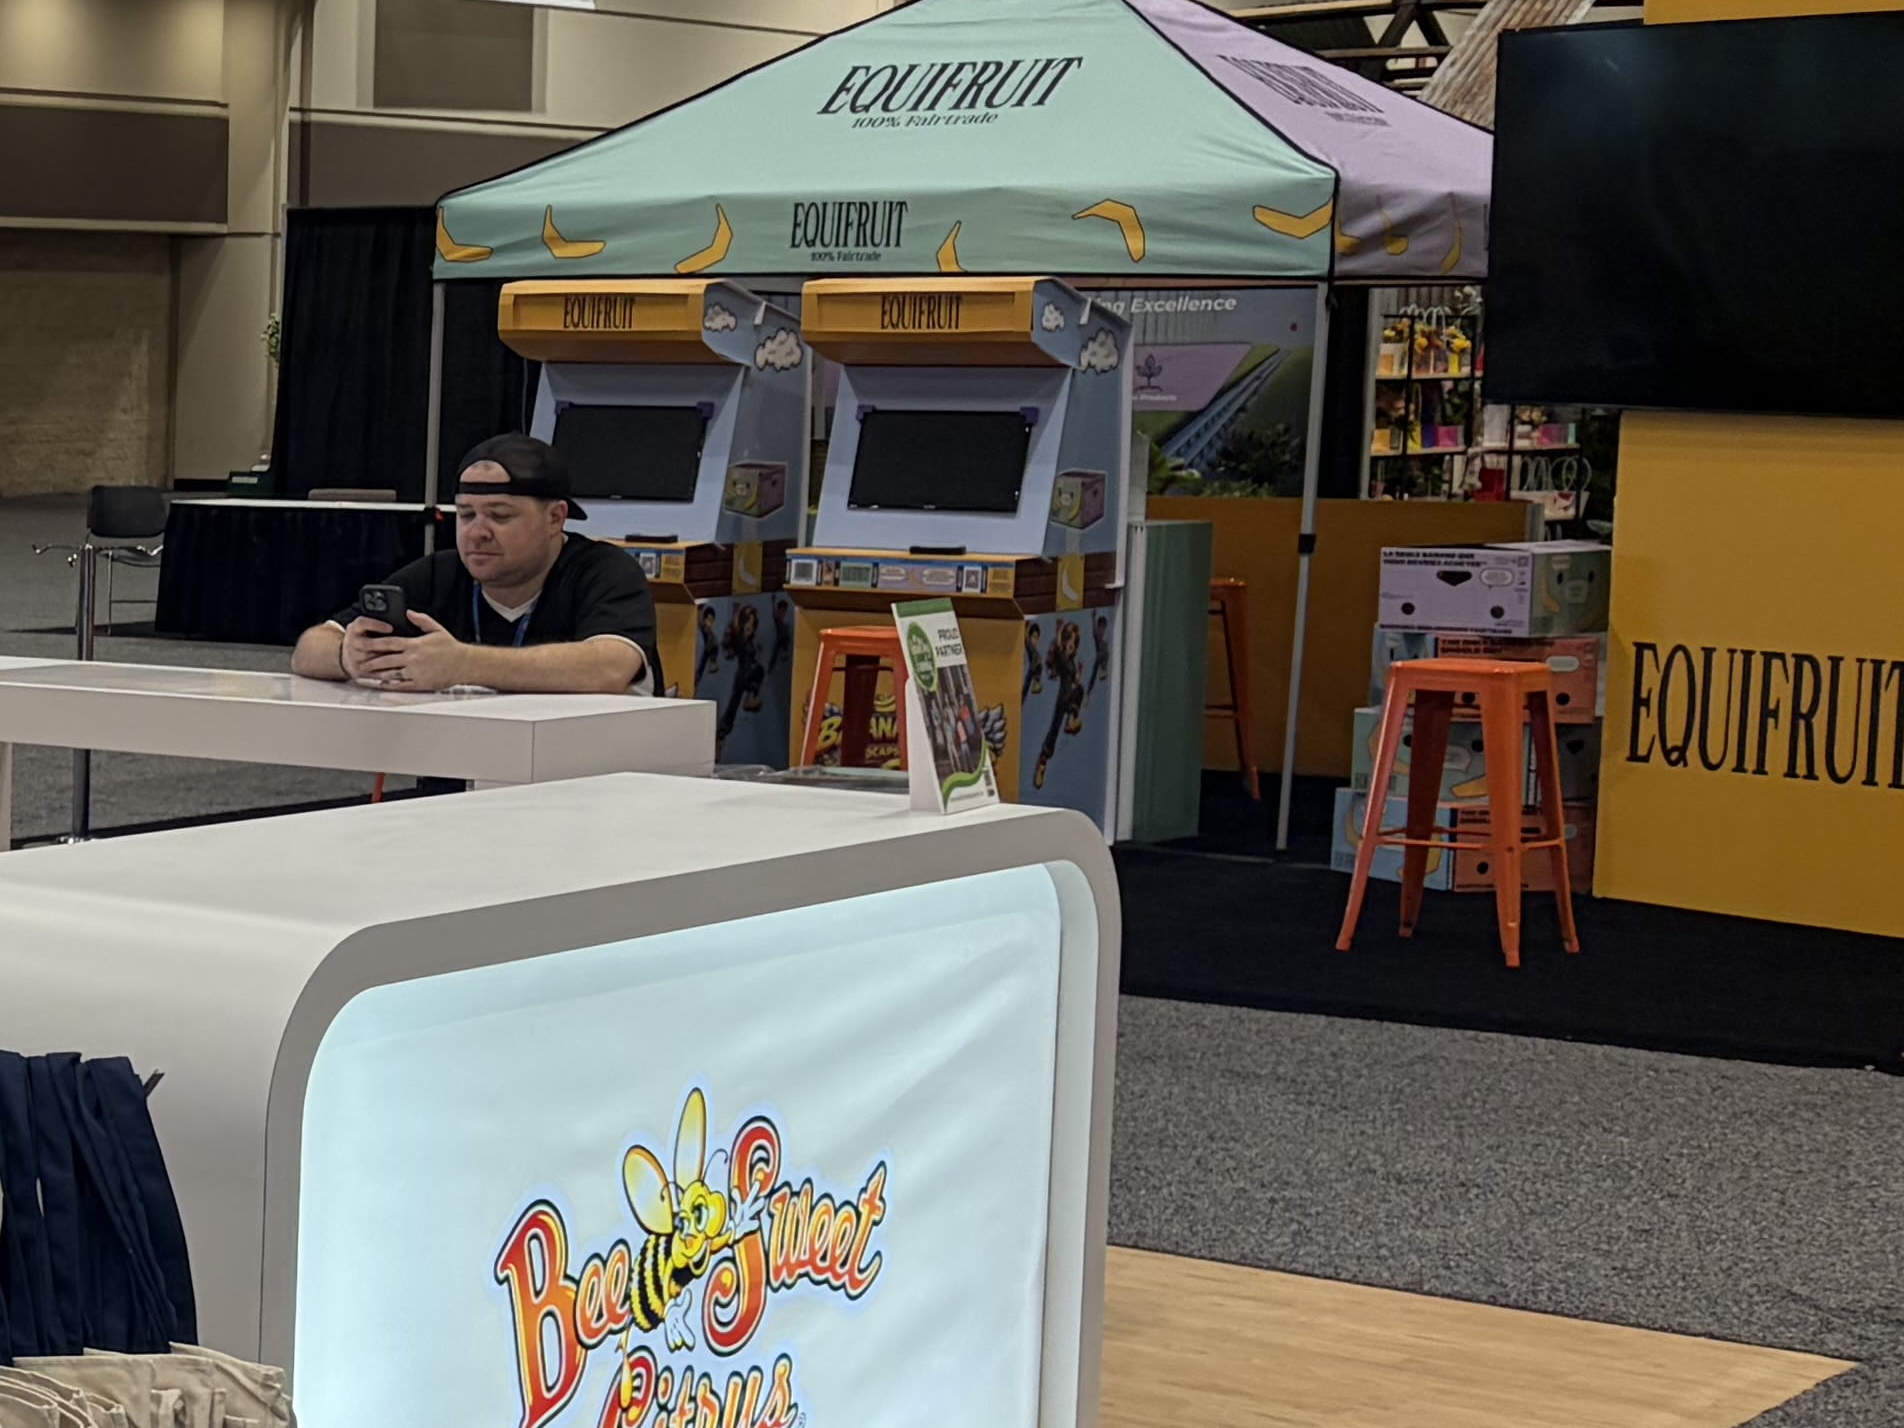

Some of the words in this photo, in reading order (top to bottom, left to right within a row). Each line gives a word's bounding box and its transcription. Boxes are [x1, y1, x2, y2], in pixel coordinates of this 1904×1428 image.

[817, 56, 1085, 116] EQUIFRUIT
[851, 113, 903, 129] 100%
[905, 111, 999, 128] Fairtrade
[790, 200, 909, 249] EQUIFRUIT
[836, 250, 882, 262] Fairtrade
[562, 294, 636, 331] EQUIFRUIT
[879, 294, 963, 331] EQUIFRUIT
[1130, 296, 1239, 313] Excellence
[1625, 640, 1904, 790] EQUIFRUIT
[700, 1113, 890, 1357] Sweet
